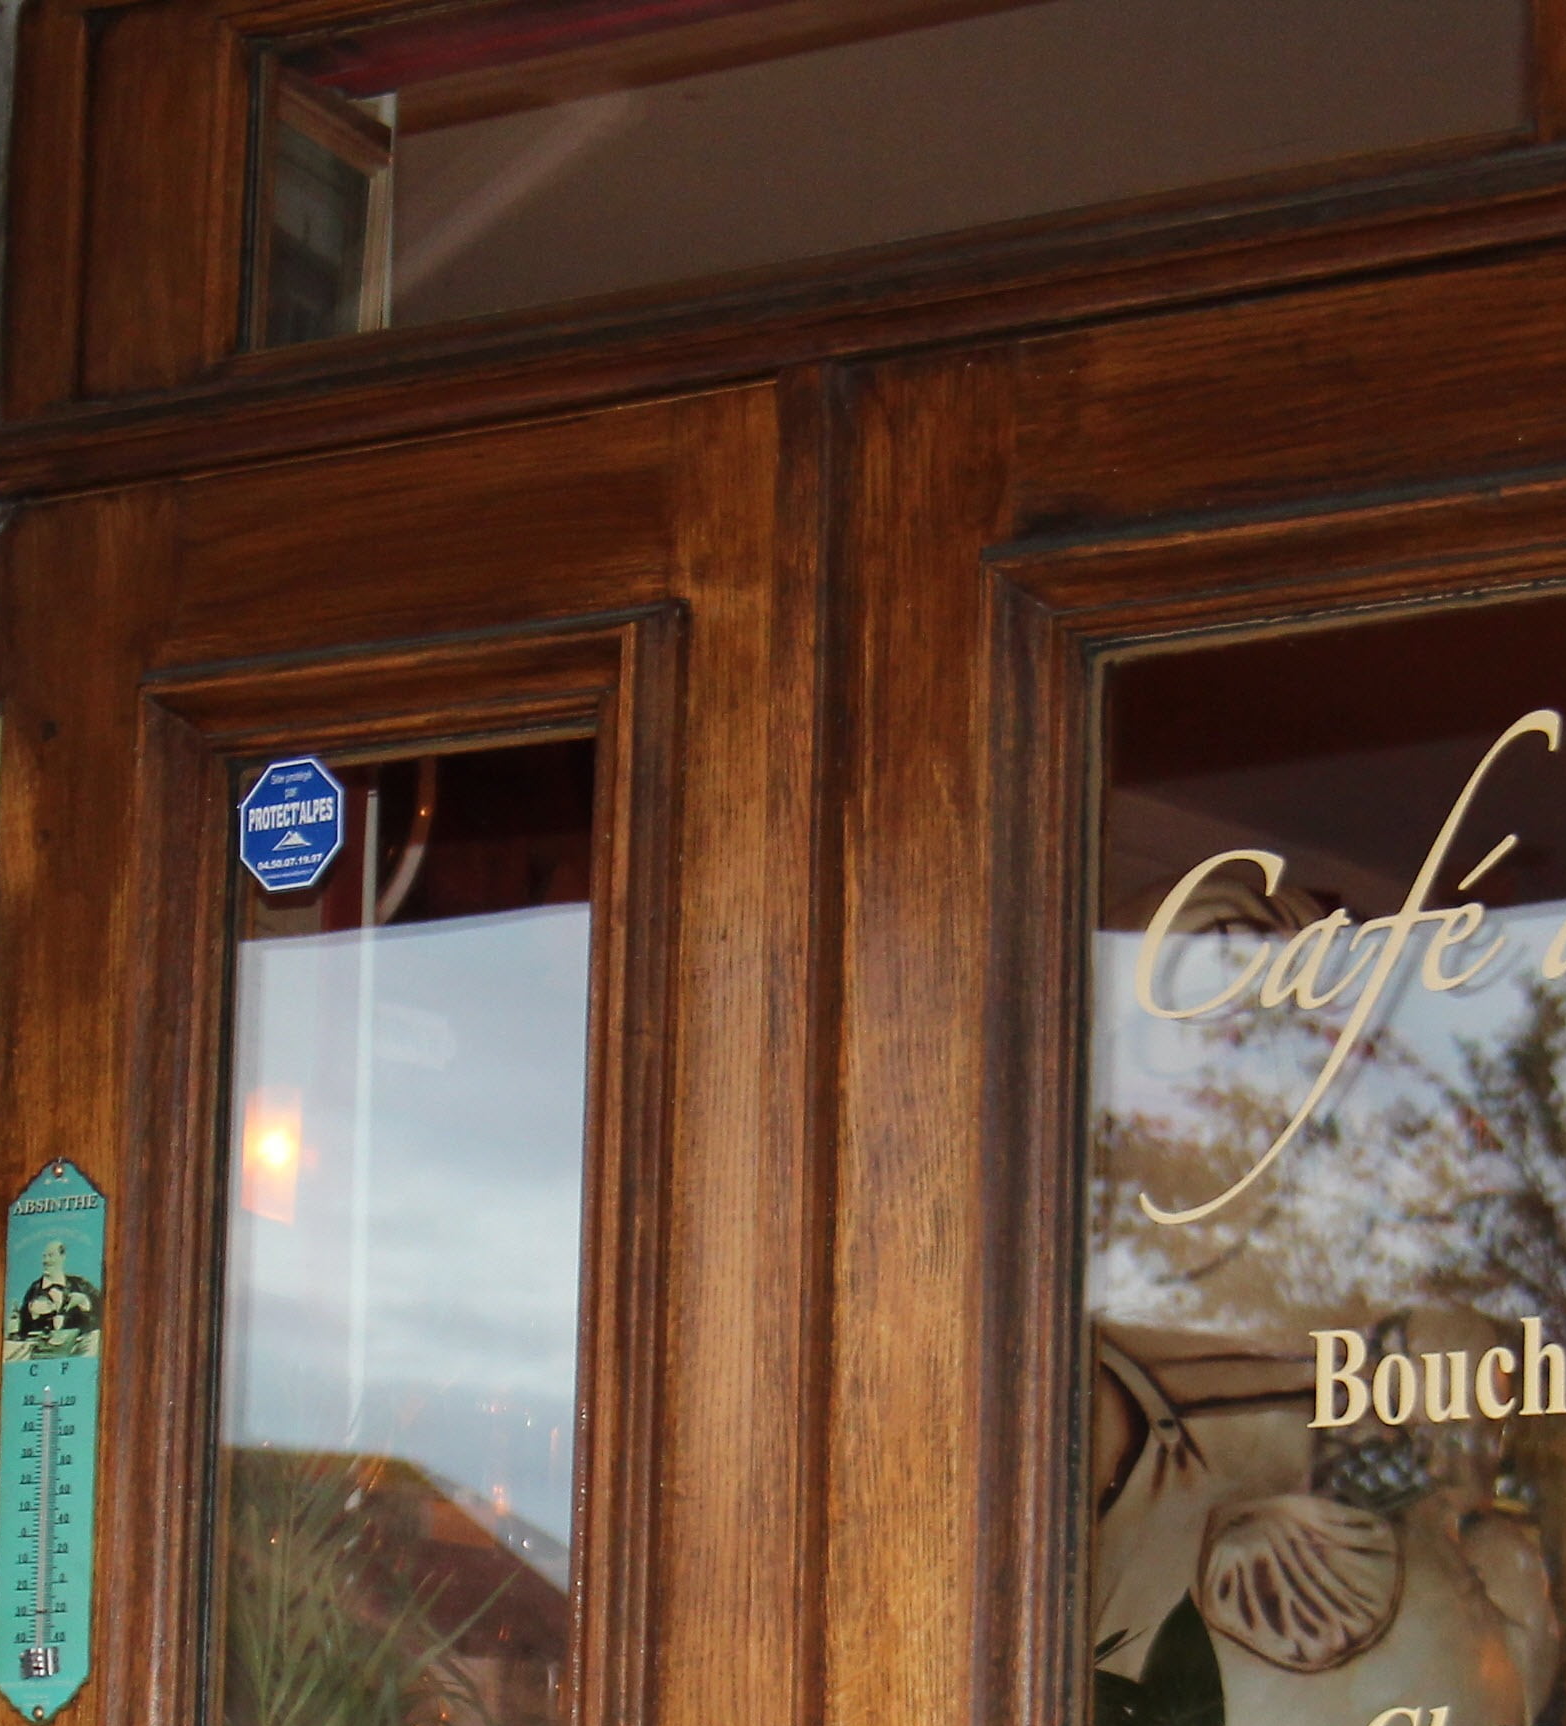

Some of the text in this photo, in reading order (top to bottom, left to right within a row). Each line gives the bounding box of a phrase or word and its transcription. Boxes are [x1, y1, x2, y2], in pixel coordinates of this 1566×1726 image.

[1136, 709, 1562, 1226] Café
[13, 1192, 98, 1216] ABSINTHE
[29, 1362, 69, 1376] C F
